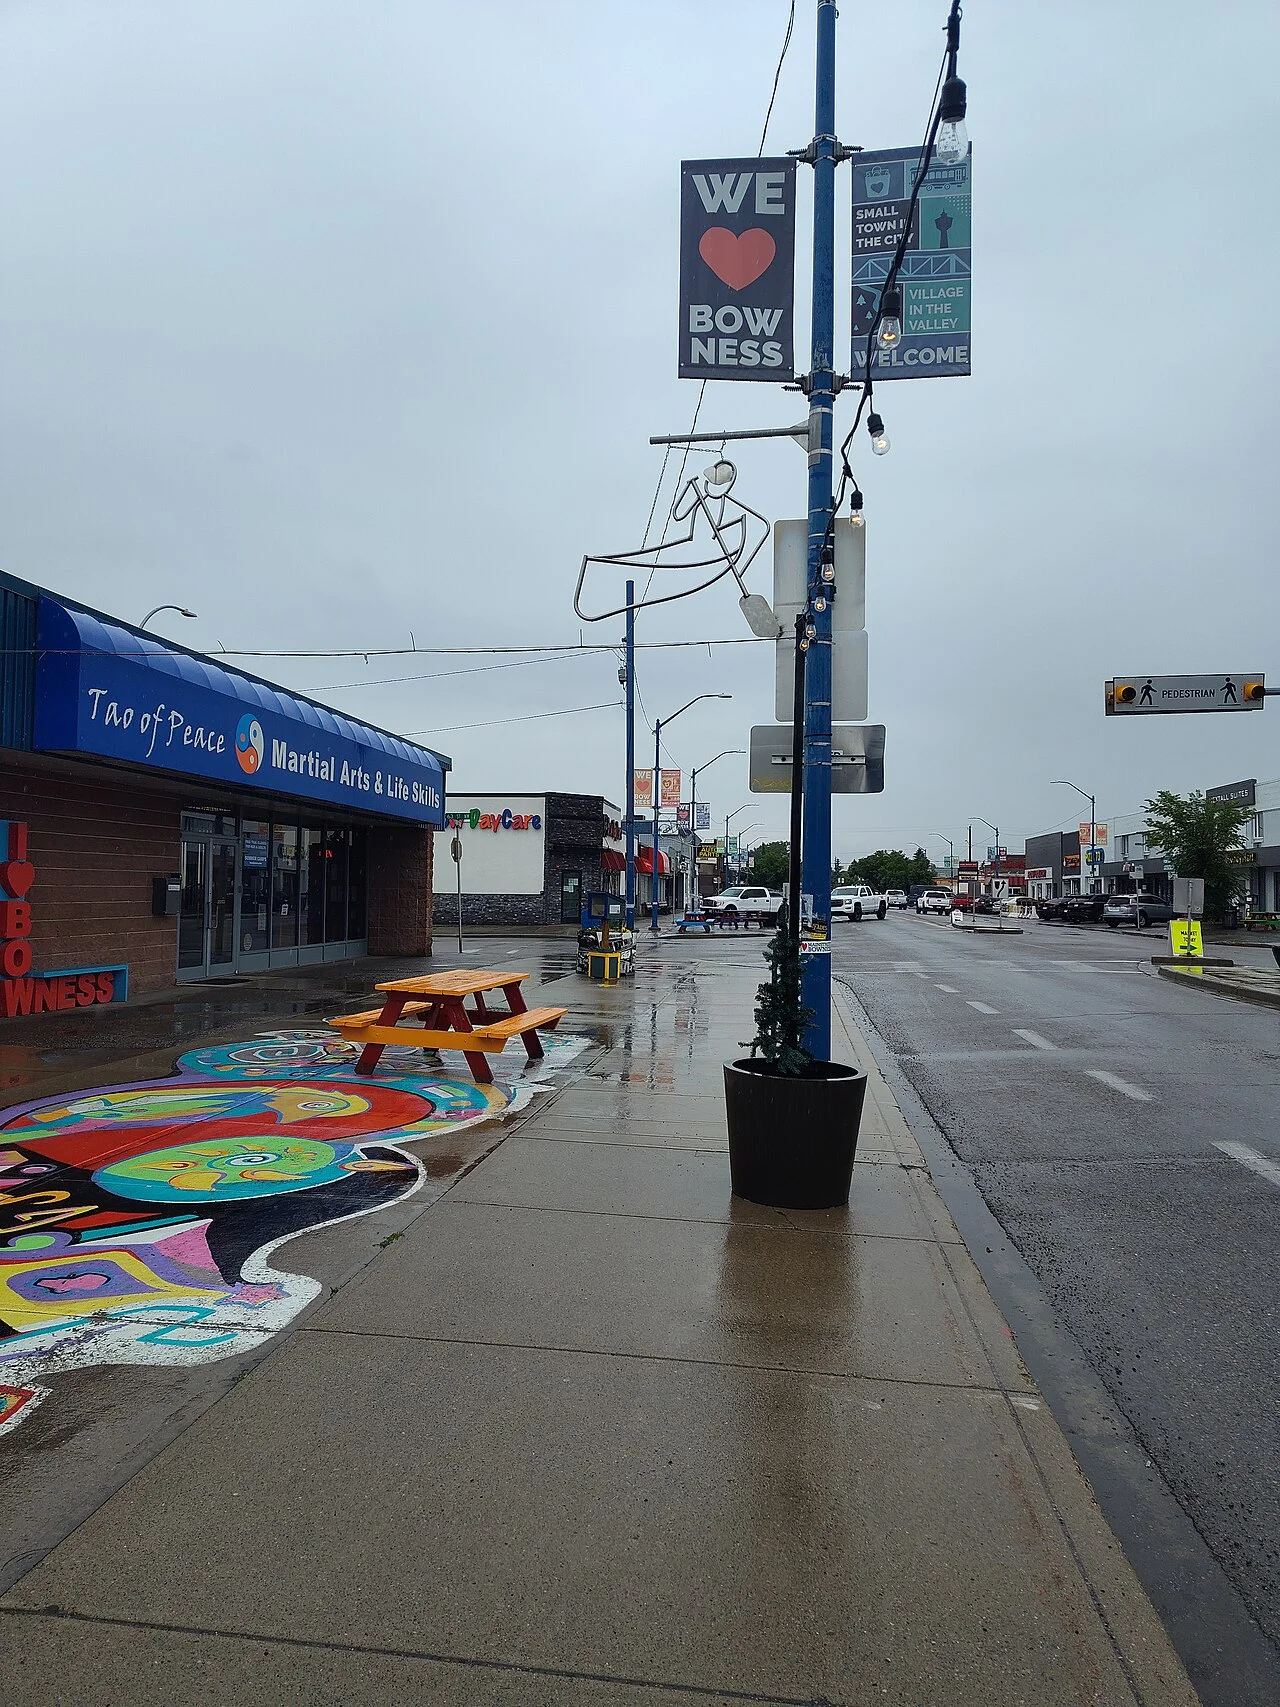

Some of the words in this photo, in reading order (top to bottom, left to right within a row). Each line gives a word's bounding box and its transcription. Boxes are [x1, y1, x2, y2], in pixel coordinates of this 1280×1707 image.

[692, 172, 785, 214] WE
[856, 206, 899, 219] SMALL
[856, 219, 897, 233] TOWN
[856, 236, 882, 248] THE
[909, 287, 964, 300] VILLAGE
[909, 304, 922, 316] IN
[925, 303, 952, 314] THE
[689, 305, 784, 336] BOW
[909, 318, 958, 331] VALLEY
[691, 337, 784, 366] NESS
[854, 346, 968, 367] WELCOME
[1162, 689, 1215, 699] PEDESTRIAN
[88, 688, 134, 729] Tao
[140, 703, 166, 758] of
[166, 710, 226, 753] Peace
[272, 738, 335, 782] Martial
[340, 760, 370, 791] Arts
[374, 771, 383, 795] &
[387, 774, 409, 801] Life
[412, 781, 440, 809] Skills
[635, 771, 651, 779] WE
[470, 808, 542, 833] DayCare
